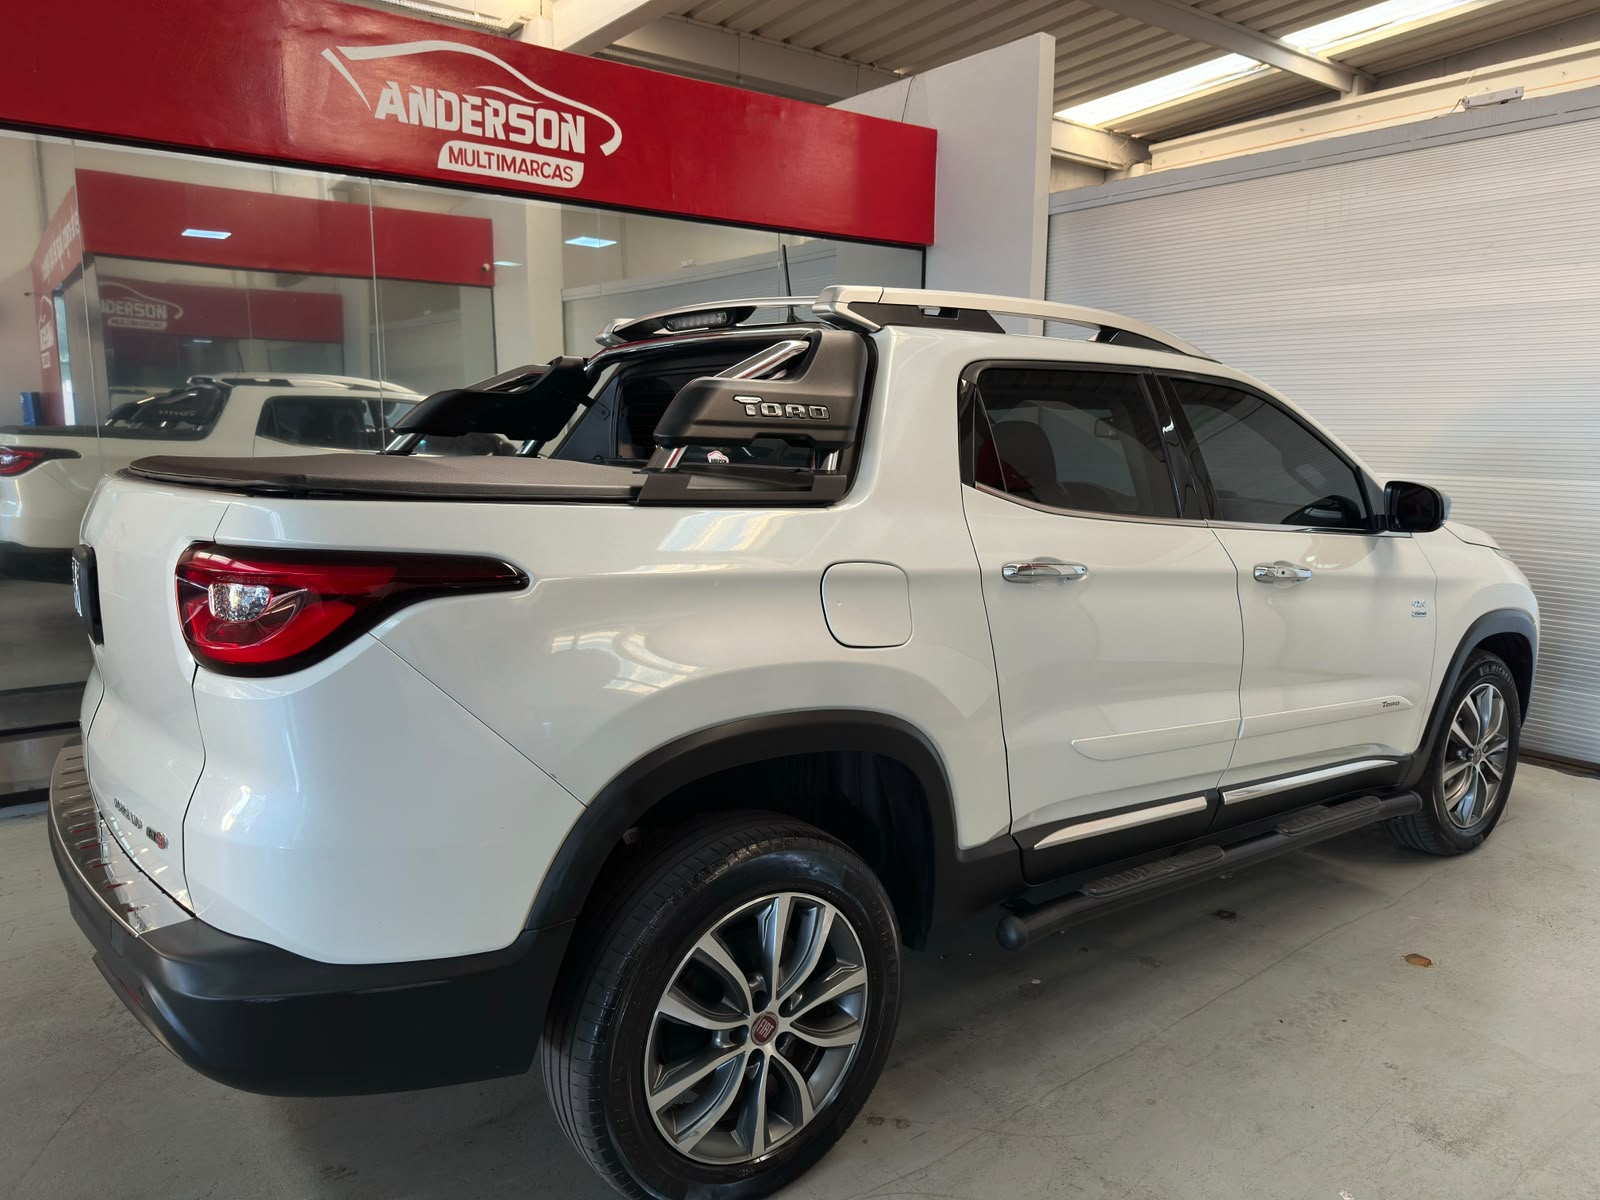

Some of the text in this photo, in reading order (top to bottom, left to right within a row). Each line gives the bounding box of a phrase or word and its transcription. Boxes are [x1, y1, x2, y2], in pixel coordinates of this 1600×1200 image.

[374, 80, 586, 154] ANDERSON
[448, 145, 574, 183] MULTIMARCAS
[733, 395, 831, 421] TORO
[756, 1018, 775, 1039] FIAT
